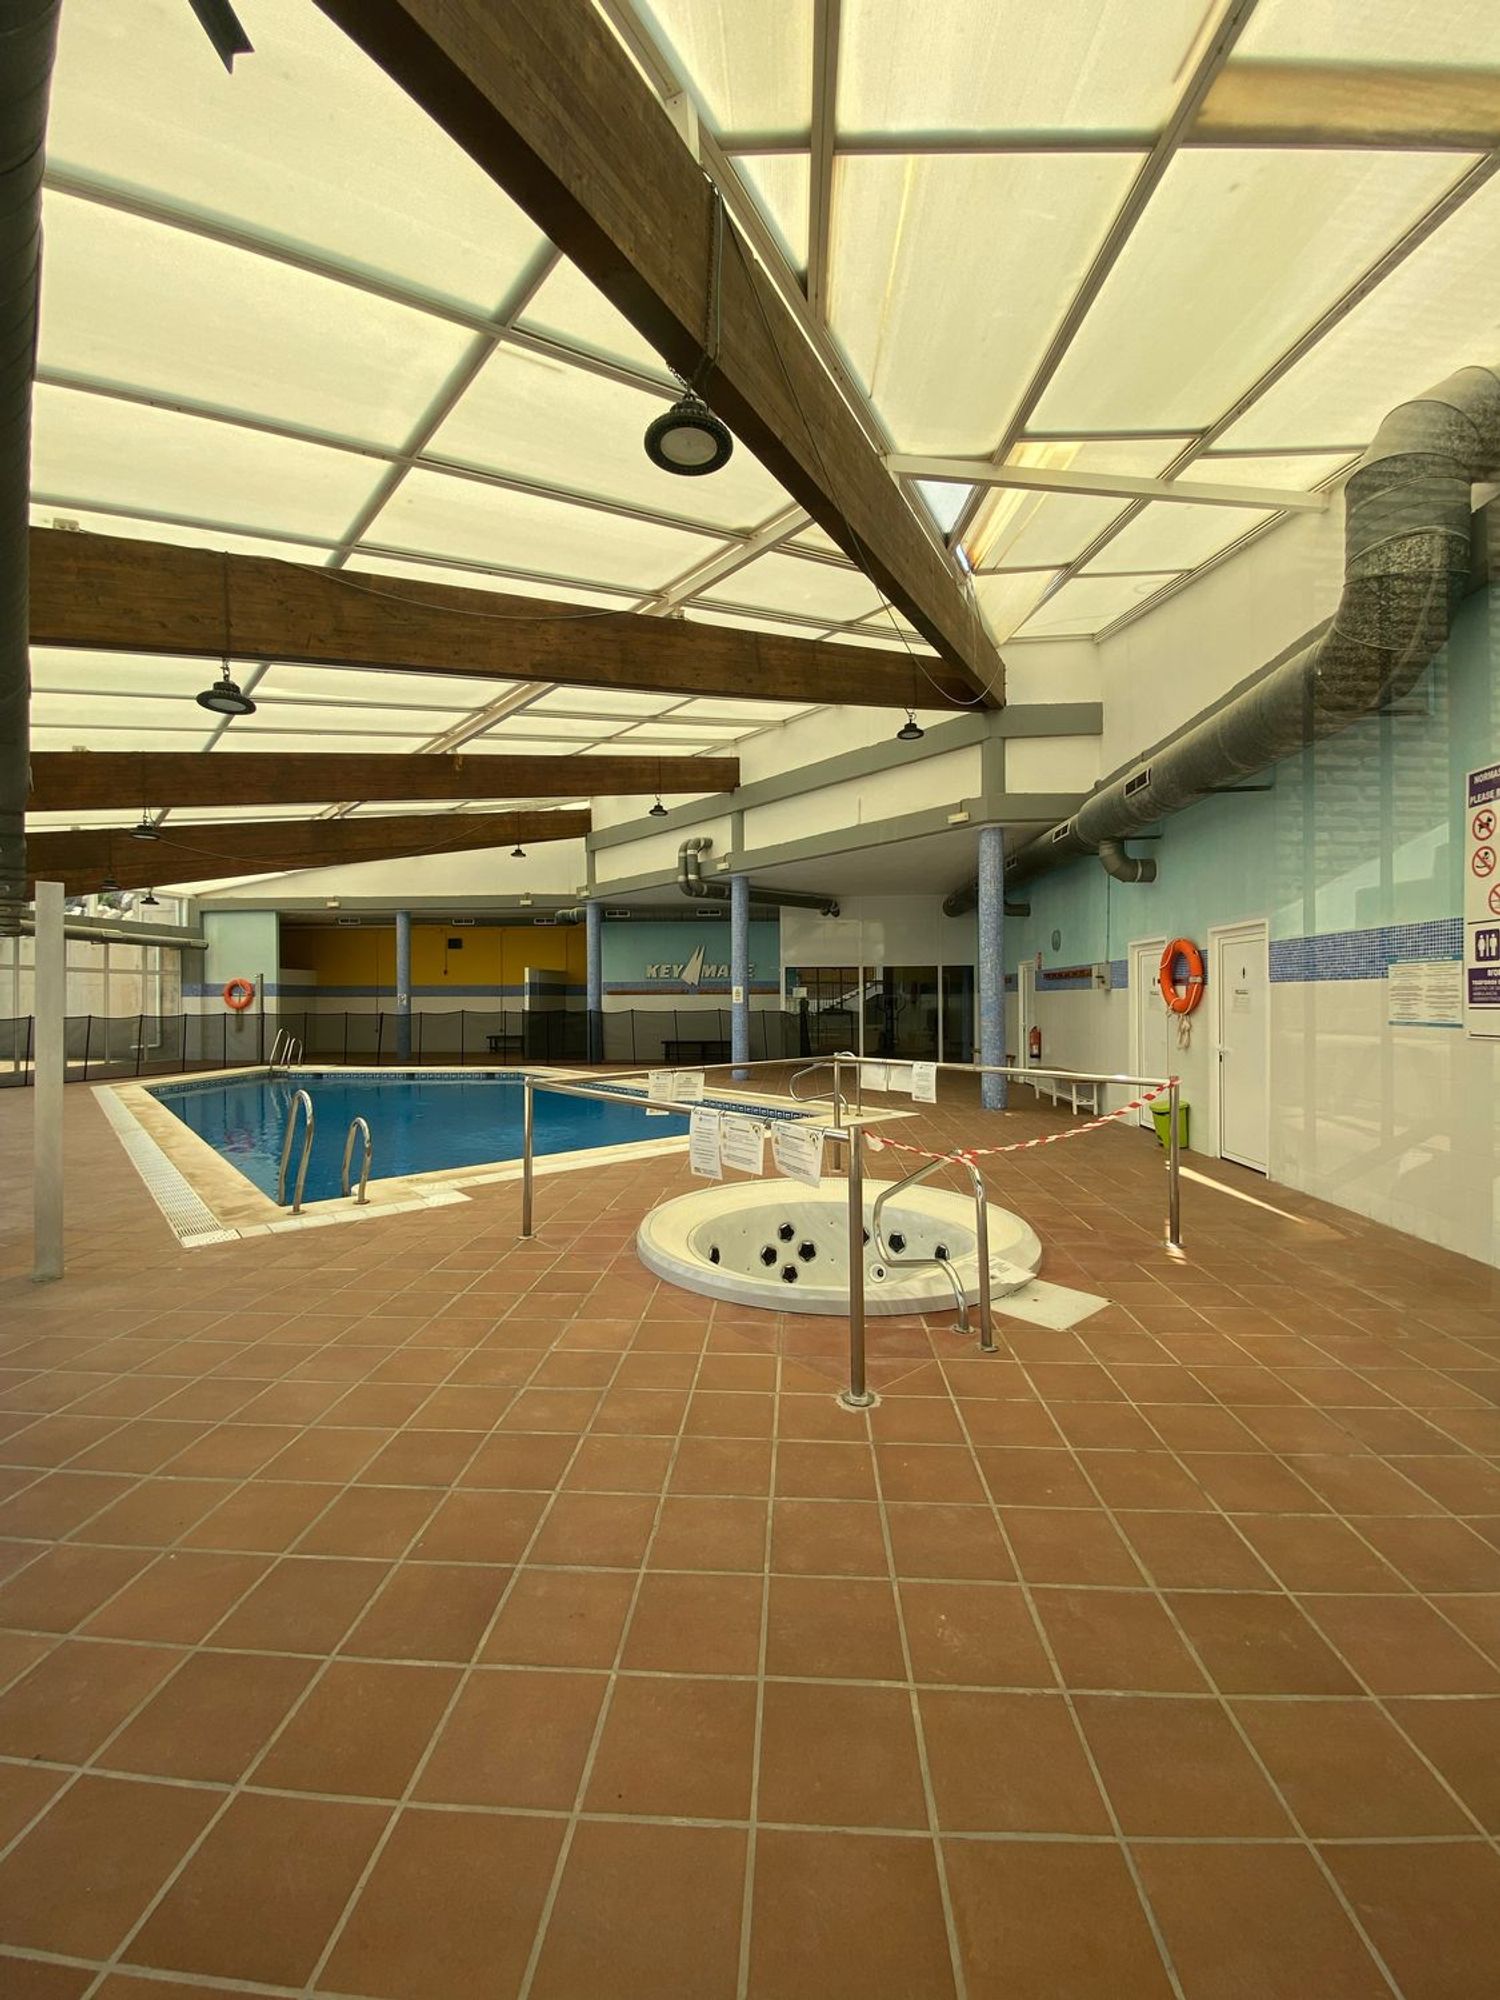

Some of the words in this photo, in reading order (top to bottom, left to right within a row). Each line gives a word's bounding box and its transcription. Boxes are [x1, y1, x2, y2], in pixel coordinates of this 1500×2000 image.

[1470, 789, 1494, 806] PLEASE
[646, 964, 684, 978] KEY
[701, 964, 755, 978] MAE
